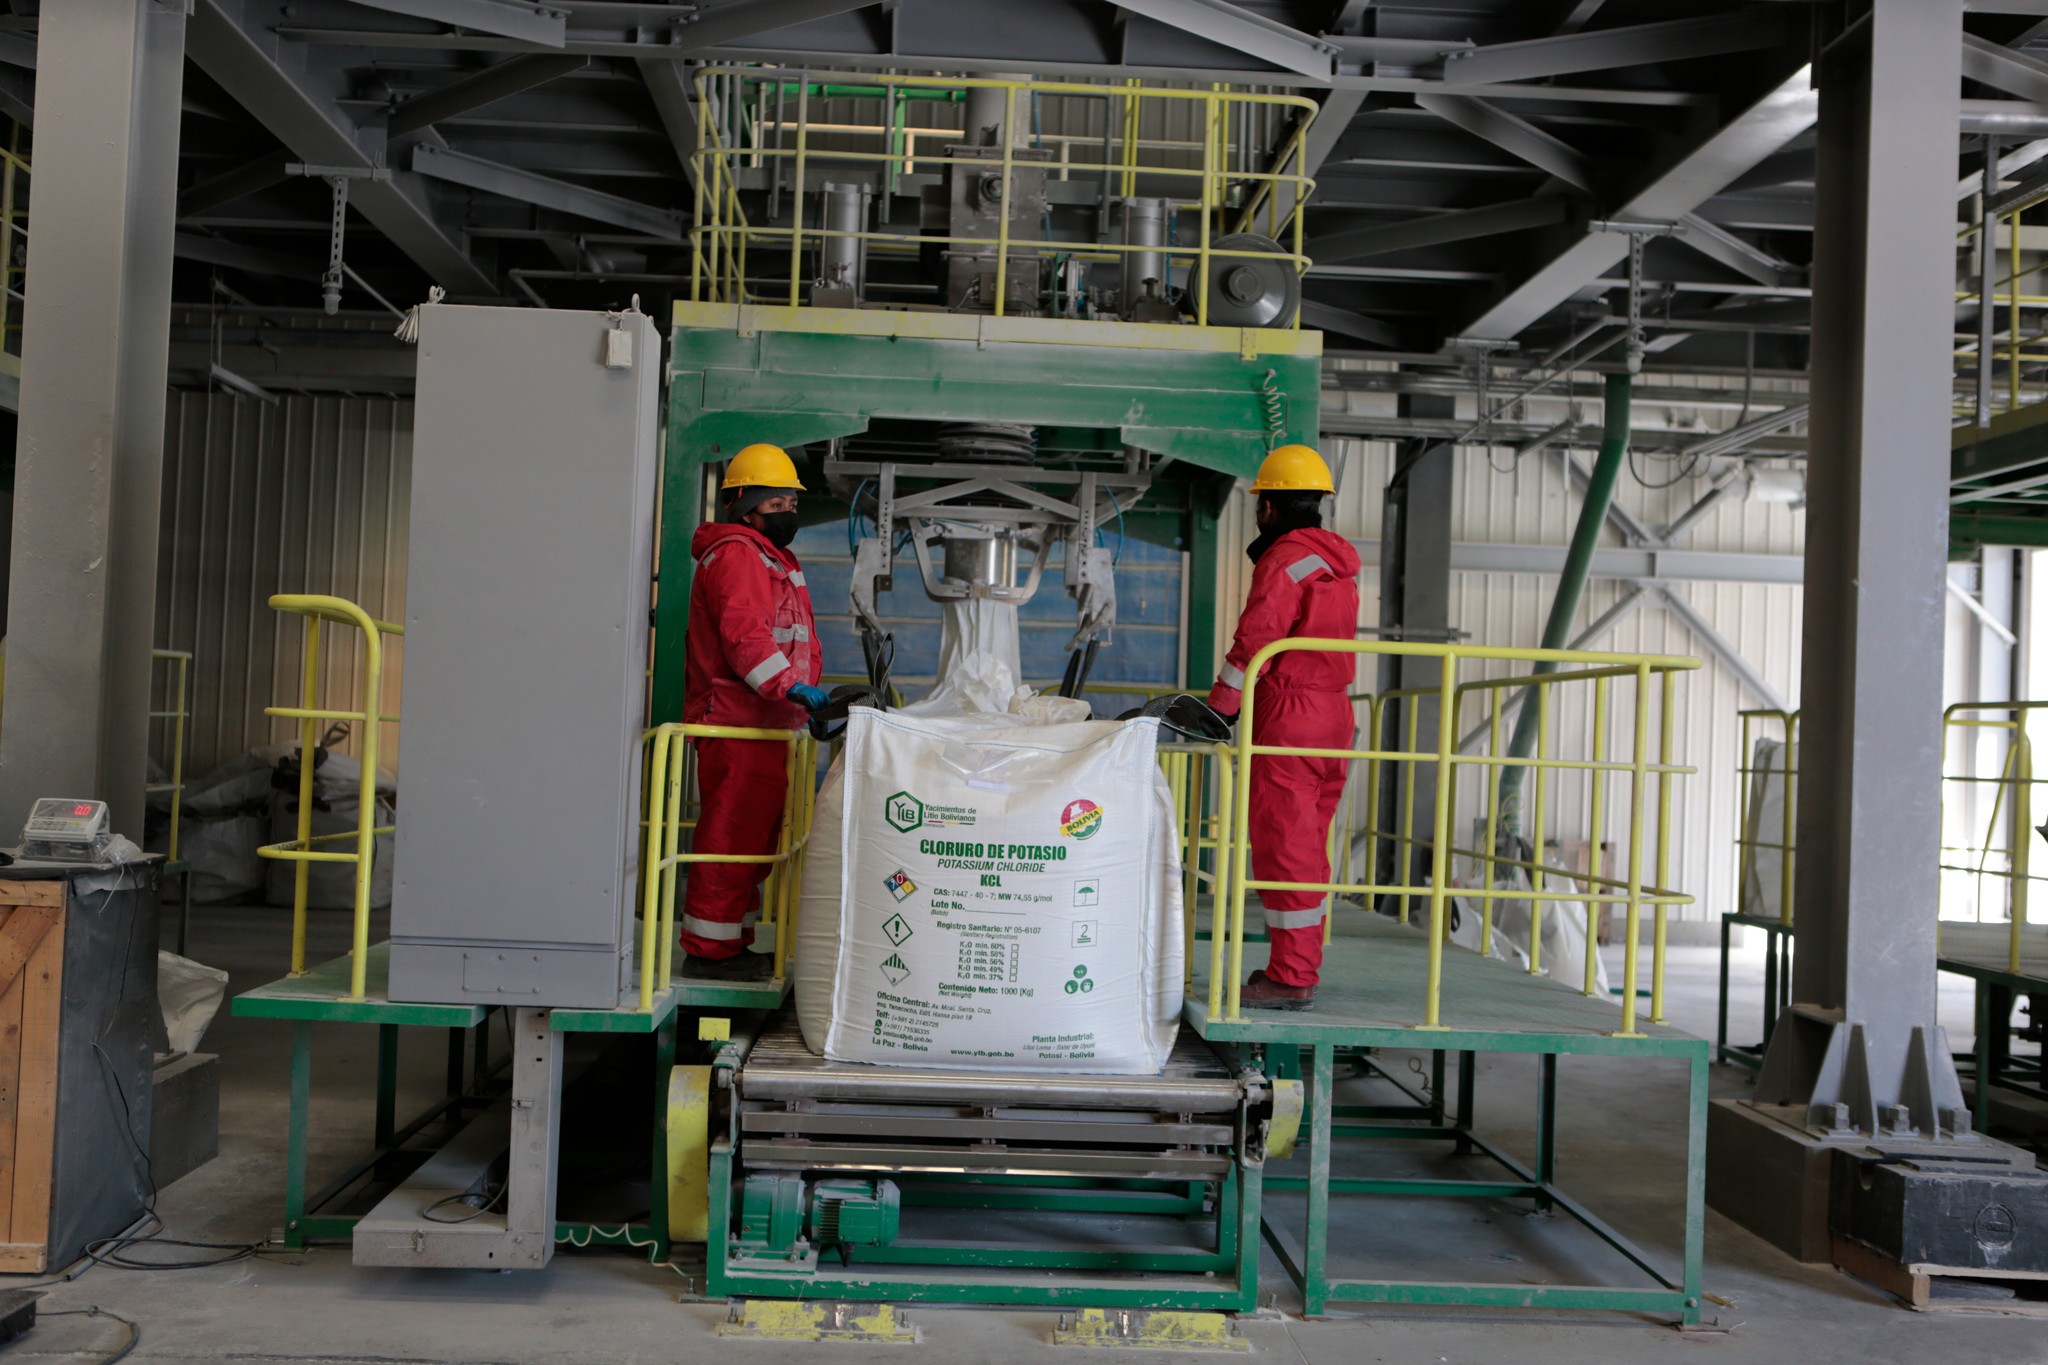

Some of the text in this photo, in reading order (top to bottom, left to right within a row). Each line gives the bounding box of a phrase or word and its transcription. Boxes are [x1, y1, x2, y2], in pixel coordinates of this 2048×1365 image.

[894, 801, 915, 823] YLB
[925, 804, 966, 813] Yacimientos
[940, 813, 976, 822] Bolivianos
[1066, 810, 1100, 832] BOLIVIA
[920, 839, 1066, 861] CLORURO DE POTASIO
[937, 859, 1045, 872] POTASSIUM CHLORIDE
[980, 874, 1001, 887] KCL
[934, 888, 950, 896] CAS:
[952, 890, 968, 898] 7447
[1014, 894, 1032, 902] 74,55
[1034, 895, 1052, 903] g/mol
[931, 900, 965, 910] Lote No.
[937, 921, 966, 931] Registro
[968, 924, 1002, 932] Sanitario:
[1081, 924, 1088, 937] 2
[938, 982, 1034, 997] Contenido Neto: 1000 [Kg]
[877, 991, 900, 1002] Oficina
[903, 997, 930, 1008] Central:
[876, 1010, 890, 1019] Telf:
[892, 1015, 907, 1023] (+591
[1032, 1032, 1094, 1043] Planta Industrial:
[873, 1037, 881, 1045] La
[883, 1039, 896, 1048] Paz
[903, 1043, 928, 1052] Bolivia
[951, 1050, 1015, 1058] www.ylb.gob.bo
